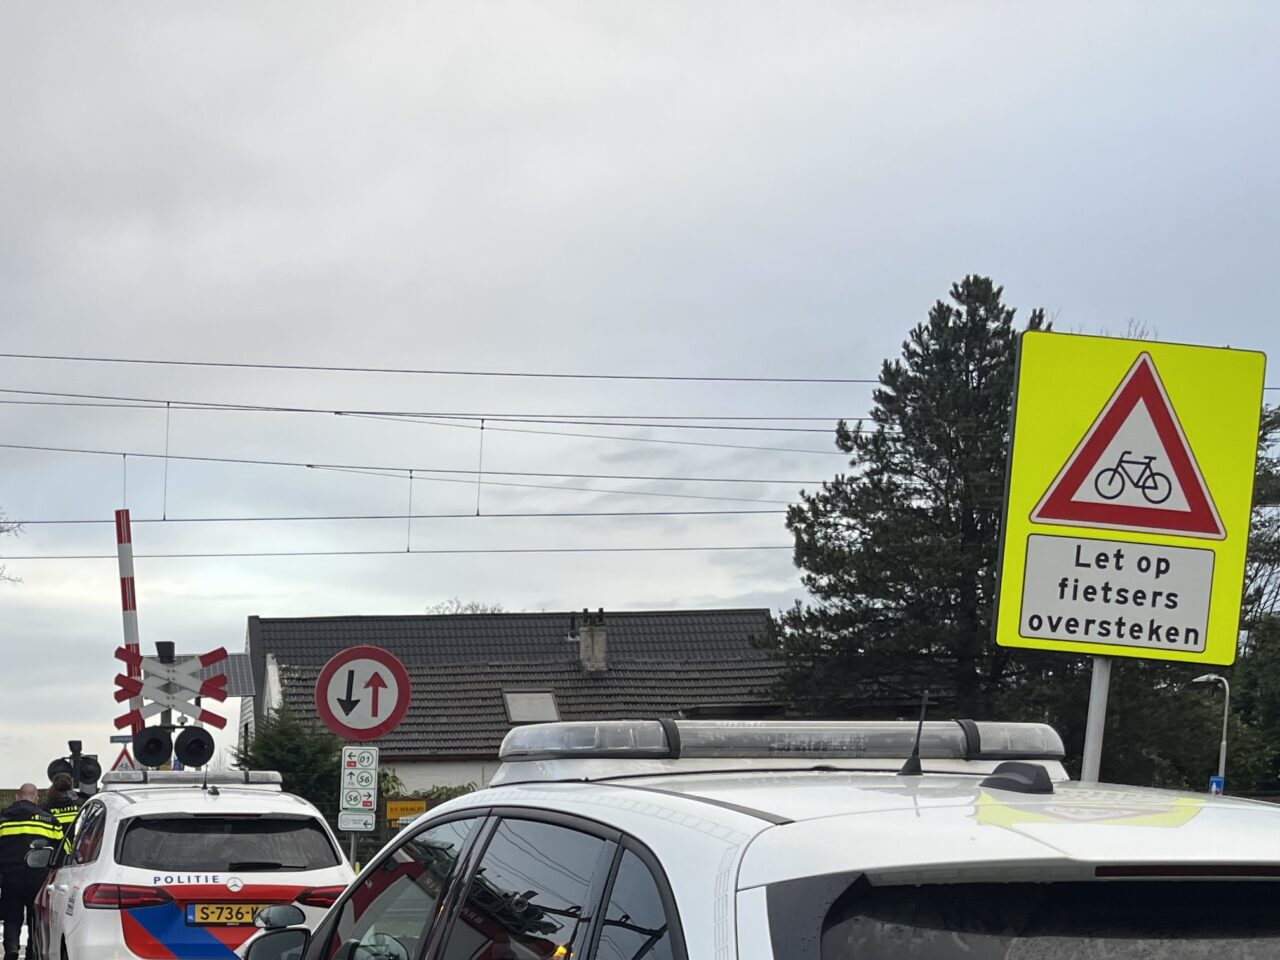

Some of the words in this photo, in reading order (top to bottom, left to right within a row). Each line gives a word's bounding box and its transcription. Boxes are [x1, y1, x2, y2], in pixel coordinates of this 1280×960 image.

[1075, 545, 1124, 571] Let
[1136, 555, 1170, 579] op
[1058, 577, 1179, 609] fietsers
[1028, 614, 1199, 645] oversteken
[153, 875, 220, 884] POLITIE
